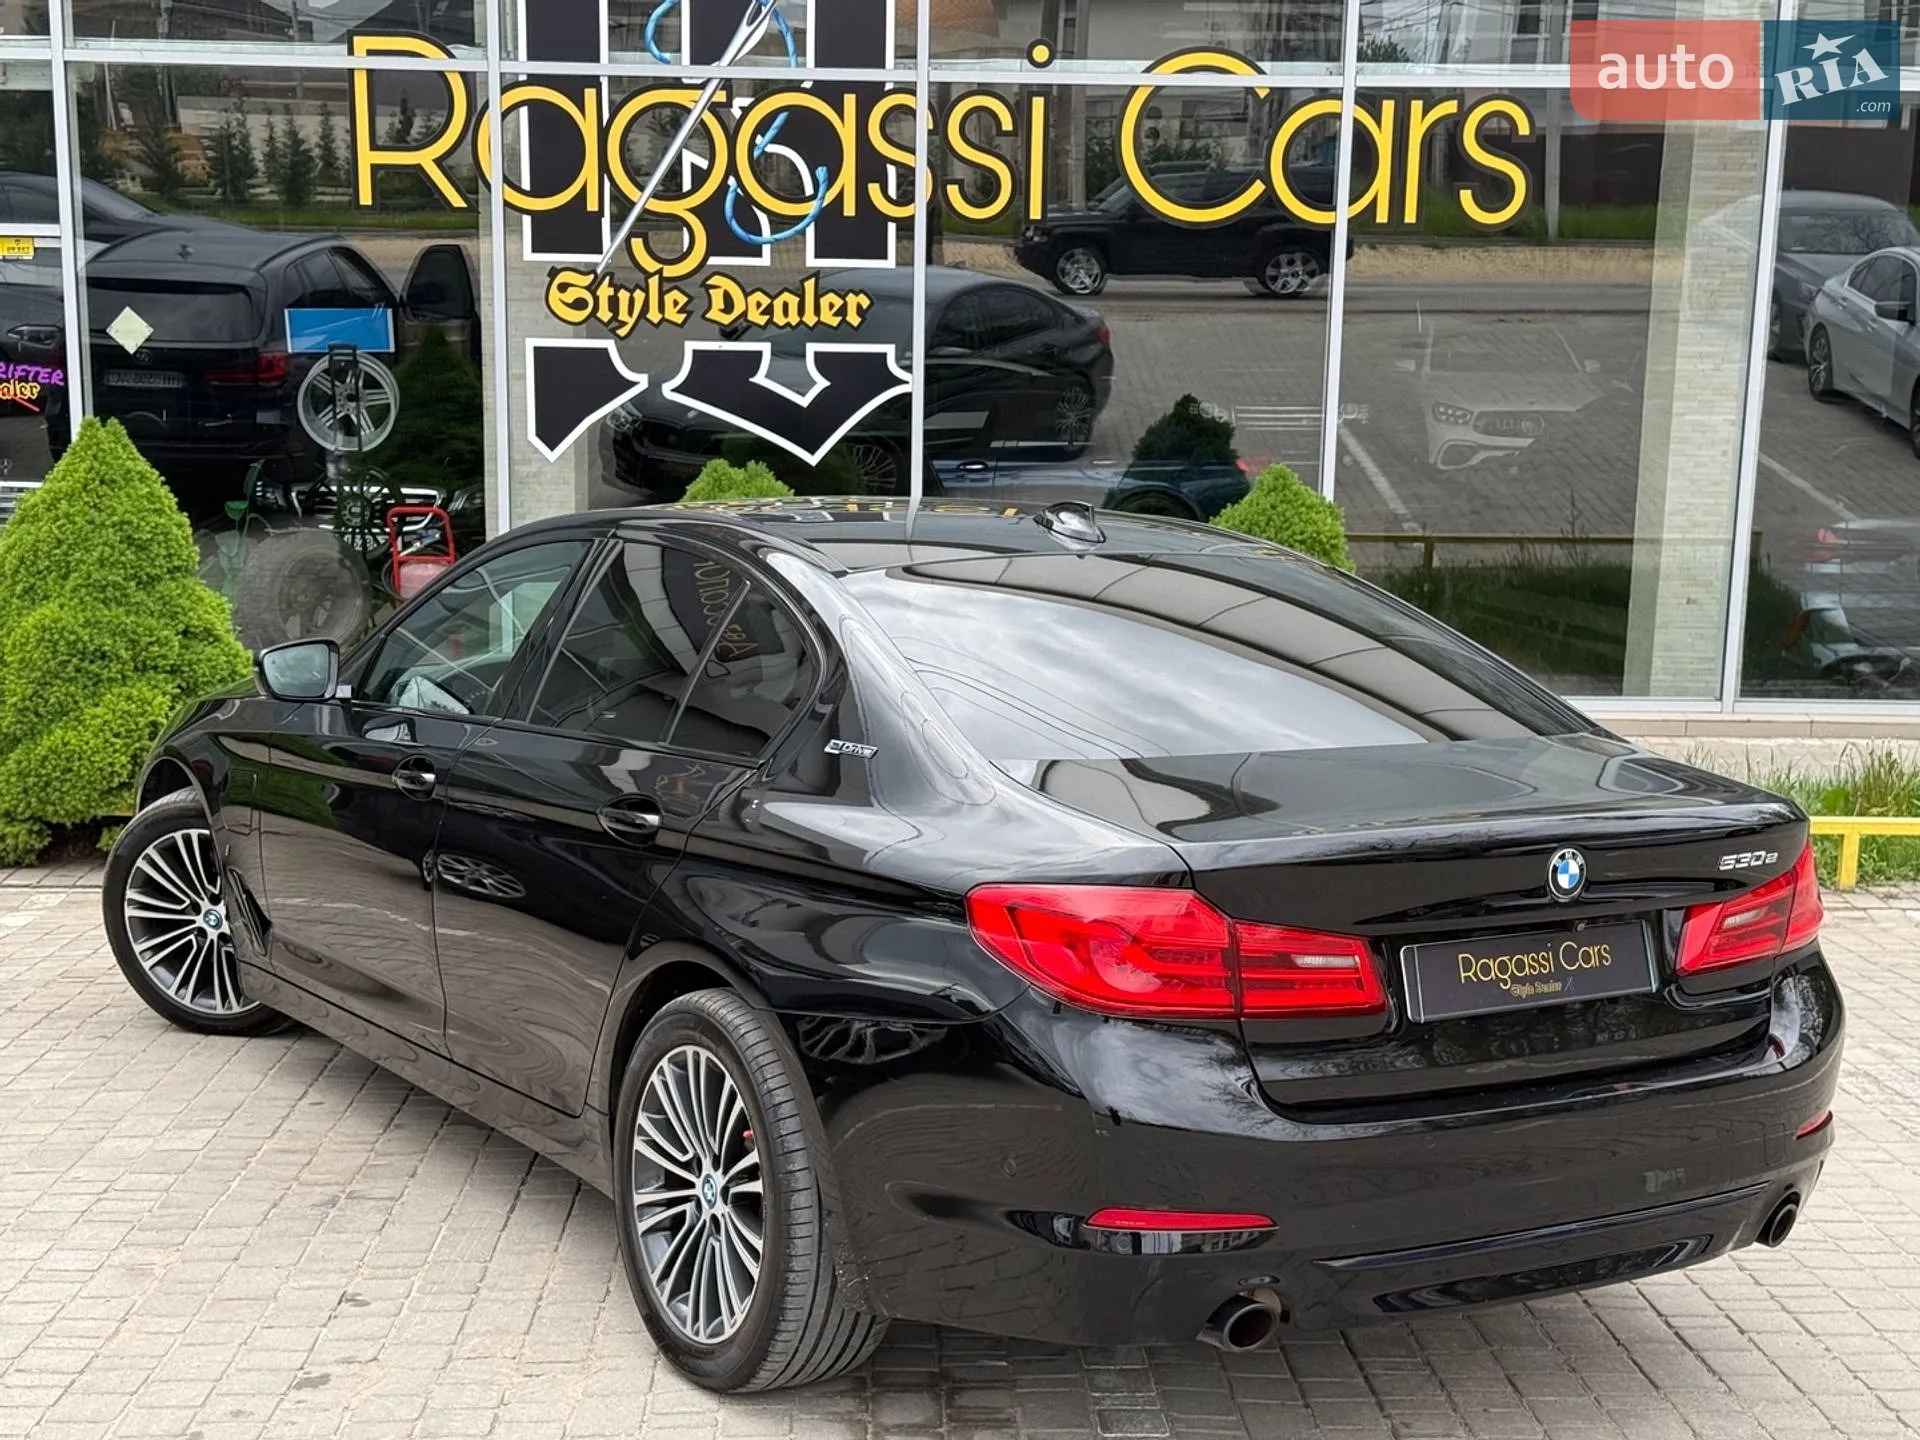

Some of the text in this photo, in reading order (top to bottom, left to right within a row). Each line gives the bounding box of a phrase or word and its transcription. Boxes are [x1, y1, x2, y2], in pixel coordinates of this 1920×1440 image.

[349, 31, 1533, 279] Ragassi Cars
[546, 268, 872, 338] Style Dealer
[1718, 851, 1779, 871] 530e
[1457, 941, 1612, 990] Ragassi Cars
